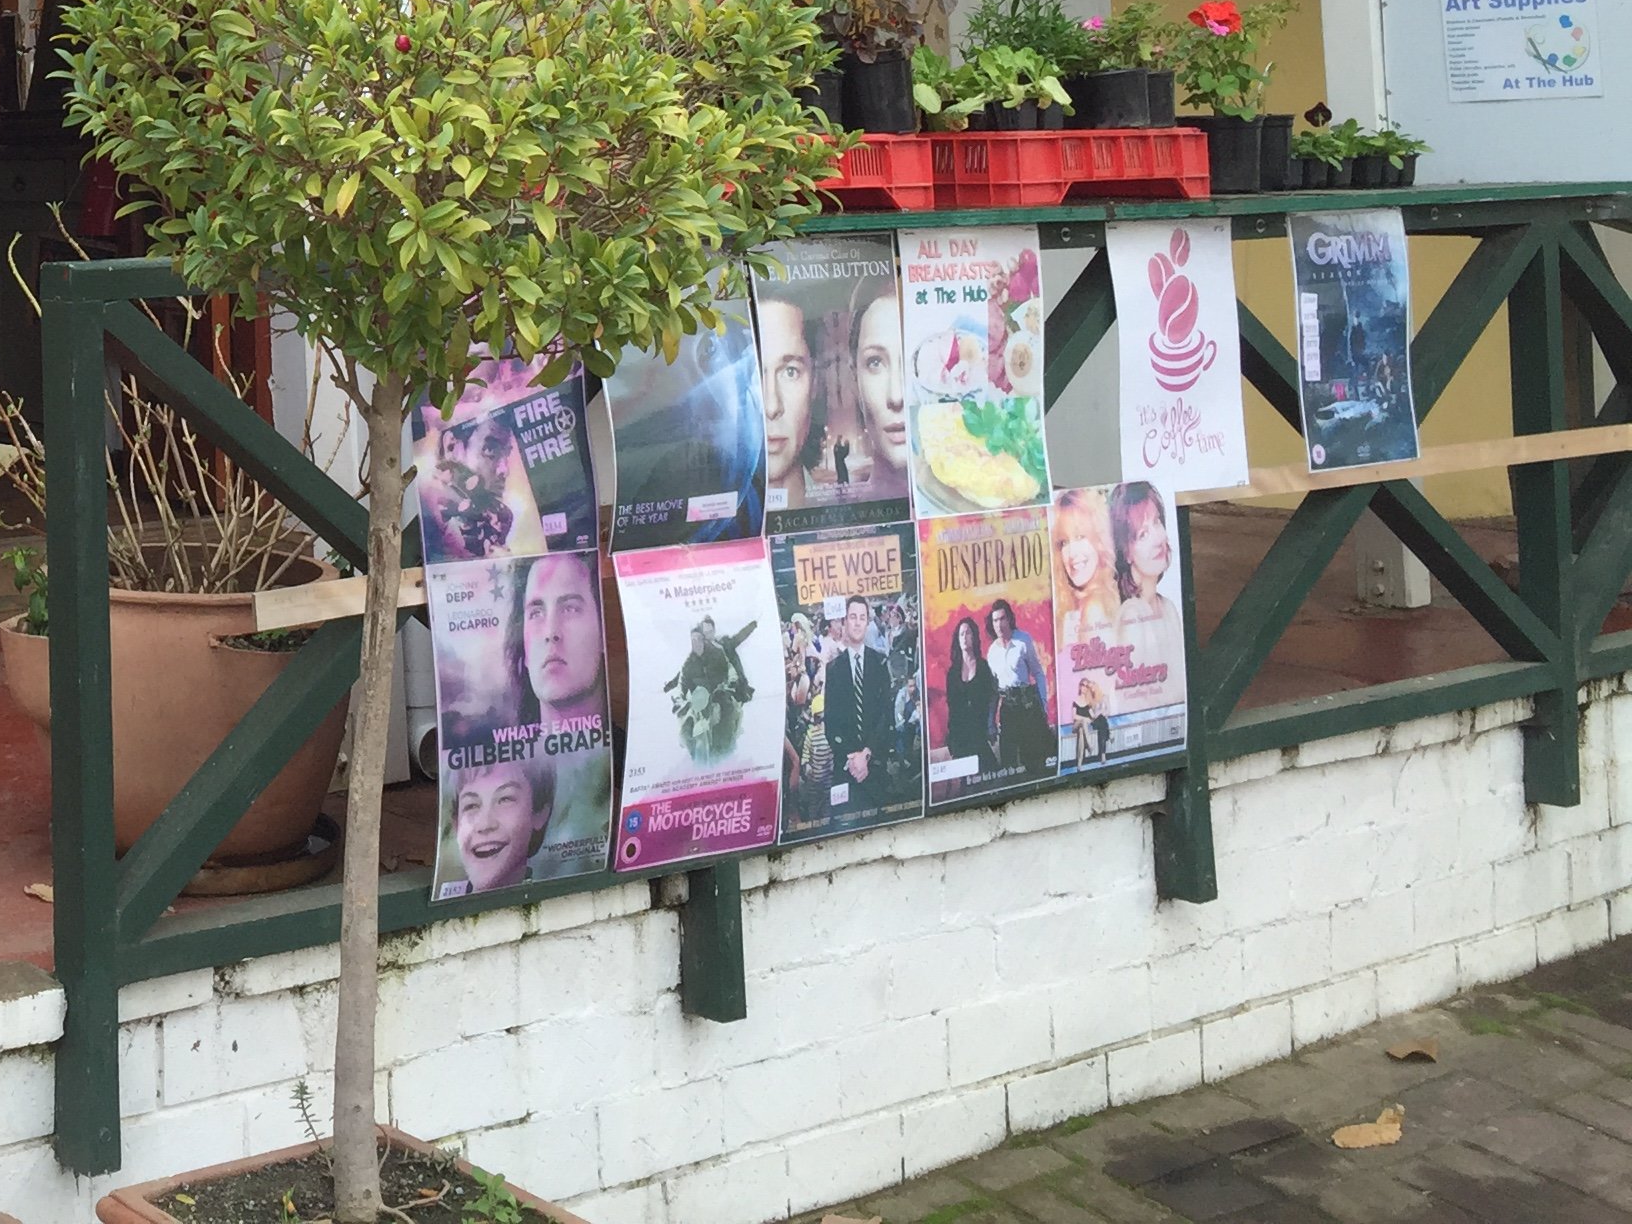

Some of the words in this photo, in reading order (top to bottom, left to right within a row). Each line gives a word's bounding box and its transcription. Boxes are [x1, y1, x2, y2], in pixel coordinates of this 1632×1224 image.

[1502, 78, 1521, 90] At
[1526, 76, 1556, 88] The
[1562, 74, 1594, 87] Hub
[917, 239, 942, 259] ALL
[948, 238, 978, 257] DAY
[832, 260, 890, 278] BUTTON
[915, 288, 928, 305] at
[934, 286, 956, 304] The
[962, 285, 988, 303] Hub
[513, 391, 563, 428] FIRE
[520, 421, 554, 444] WITH
[525, 434, 575, 469] FIRE
[618, 504, 633, 516] THE
[635, 501, 654, 514] BEST
[656, 498, 684, 511] MOVIE
[617, 517, 629, 528] OF
[632, 514, 646, 525] THE
[648, 512, 669, 523] YEAR
[774, 515, 783, 533] 3
[798, 555, 838, 582] THE
[842, 548, 897, 576] WOLF
[937, 532, 1043, 593] DESPERADO
[446, 590, 474, 603] DEPP
[800, 584, 816, 601] OF
[819, 580, 854, 598] WALL
[857, 573, 900, 593] STREET
[492, 722, 548, 744] WHAT'S
[551, 714, 602, 734] EATING
[448, 735, 541, 770] GILBERT
[544, 729, 611, 756] GRAPE
[648, 798, 752, 833] MOTORCYCLE
[650, 800, 672, 816] THE
[629, 817, 638, 828] 15
[692, 816, 751, 841] DIARIES
